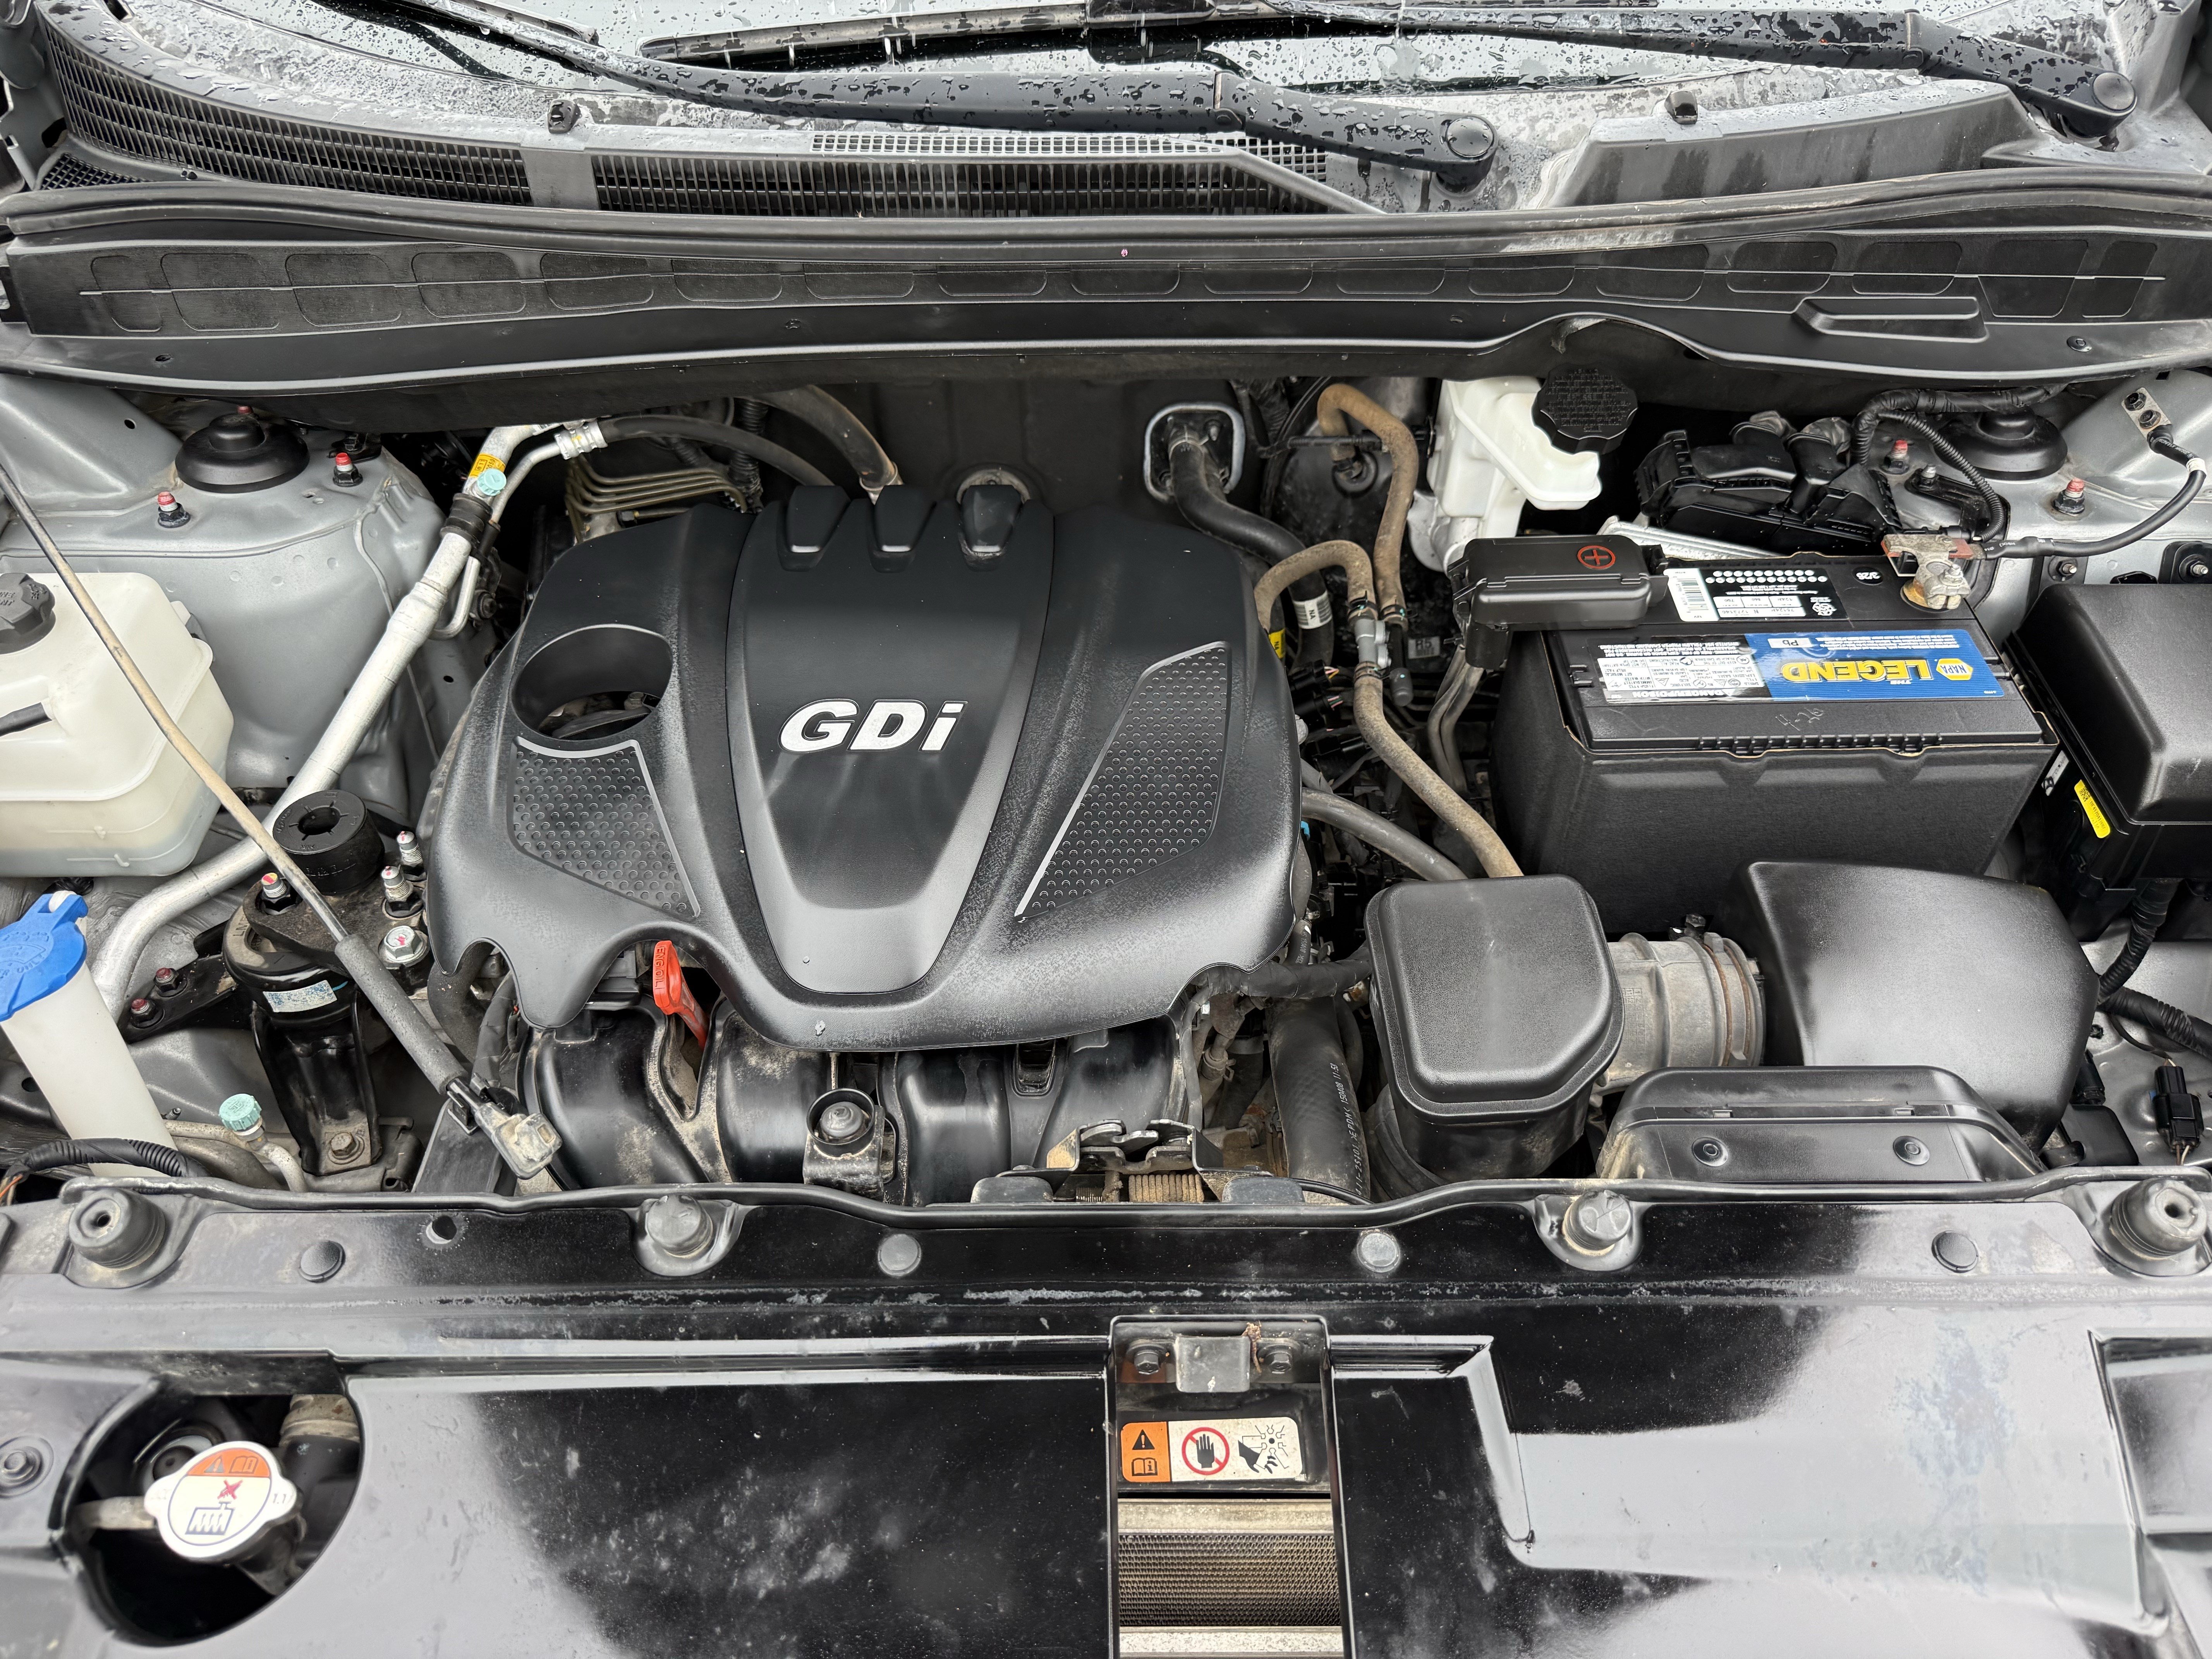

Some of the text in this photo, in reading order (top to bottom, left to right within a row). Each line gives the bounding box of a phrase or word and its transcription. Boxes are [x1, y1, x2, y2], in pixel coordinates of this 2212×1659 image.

[1780, 659, 1967, 683] NAPA LEGEND
[779, 699, 967, 752] GDi
[654, 946, 665, 987] ENG OIL
